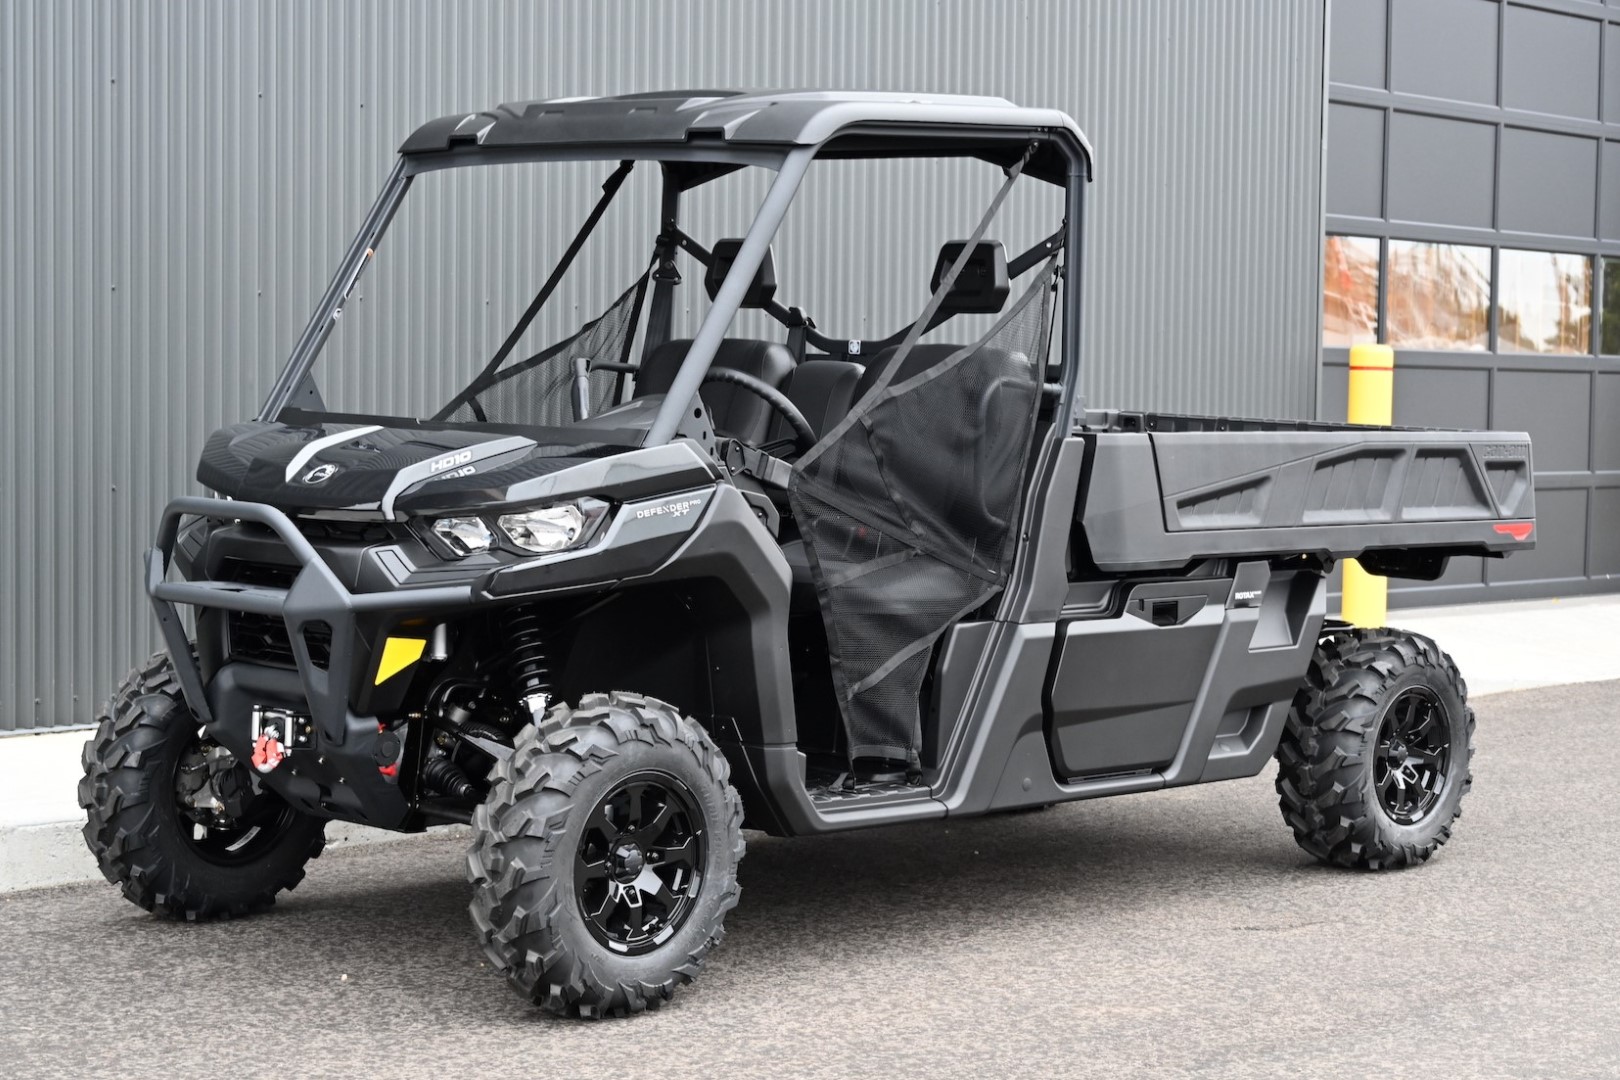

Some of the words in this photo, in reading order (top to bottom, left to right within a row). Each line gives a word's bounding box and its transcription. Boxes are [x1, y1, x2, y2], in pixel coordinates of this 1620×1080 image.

[431, 450, 473, 473] HD10
[636, 501, 690, 519] DEFENDER
[689, 498, 702, 506] PRO
[672, 508, 690, 518] XT
[1234, 591, 1255, 600] ROTAX
